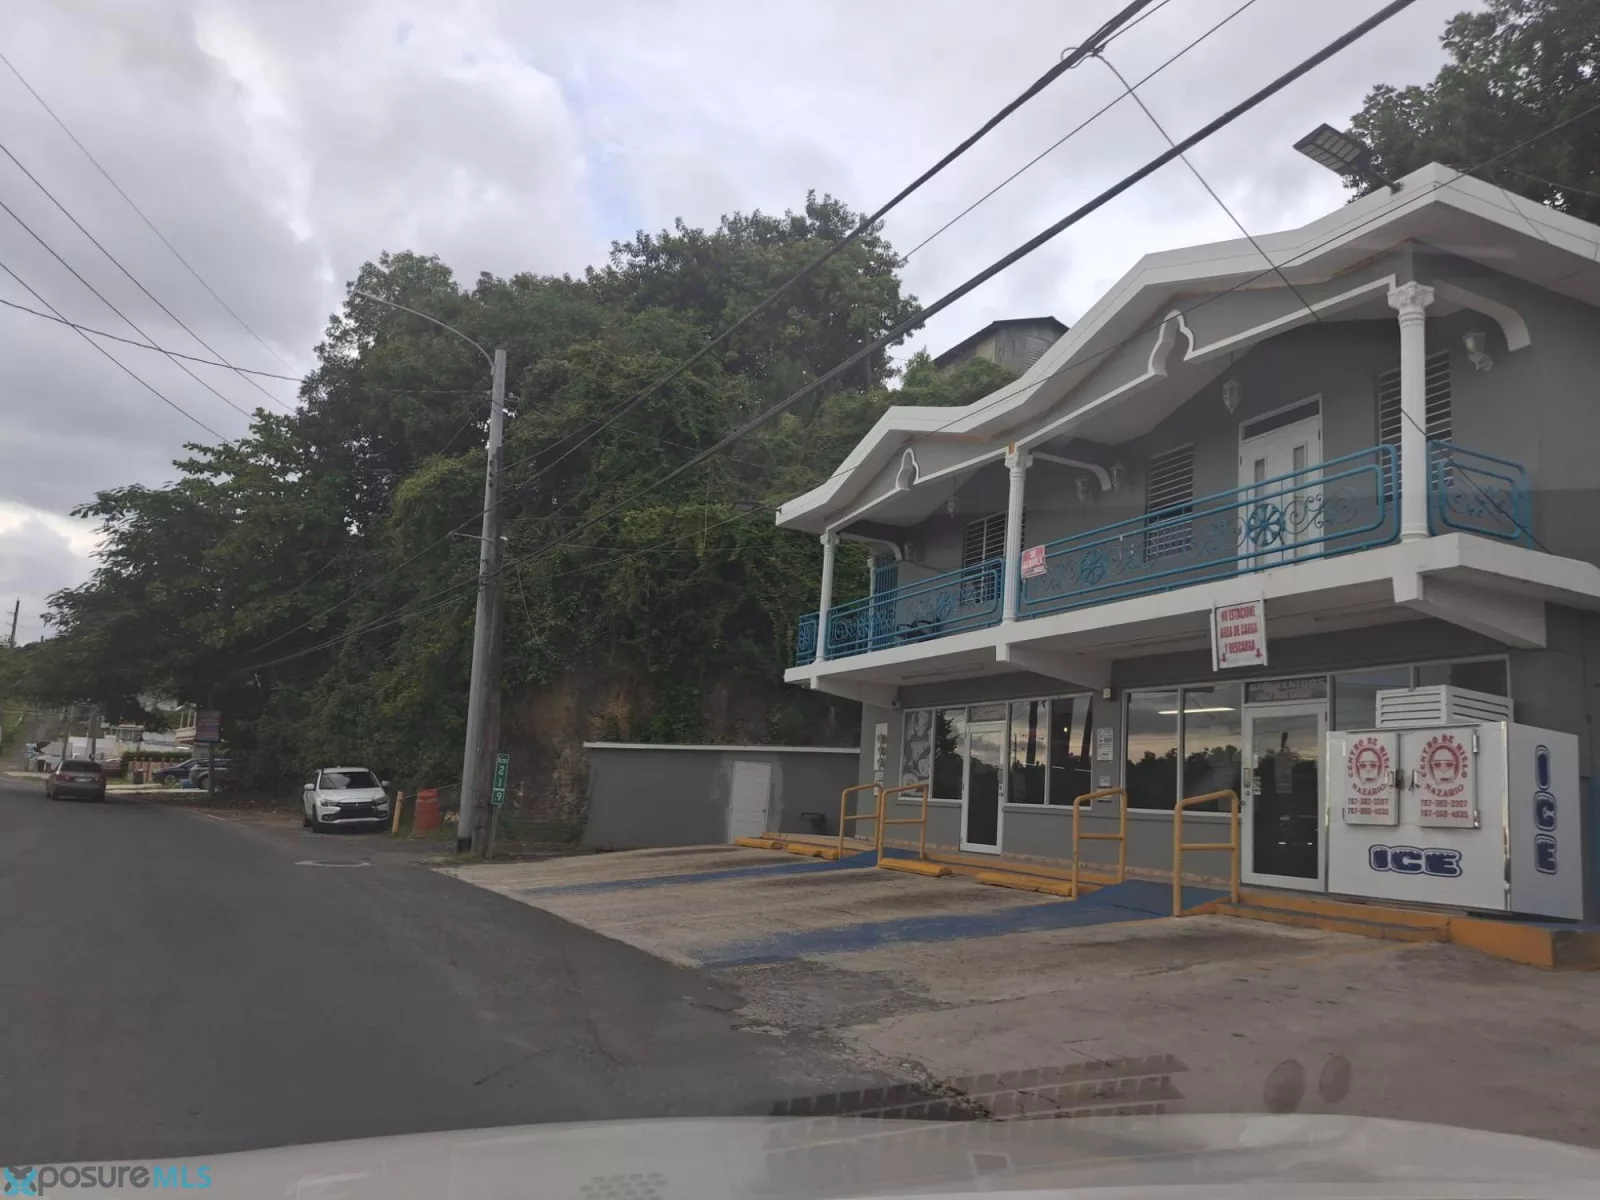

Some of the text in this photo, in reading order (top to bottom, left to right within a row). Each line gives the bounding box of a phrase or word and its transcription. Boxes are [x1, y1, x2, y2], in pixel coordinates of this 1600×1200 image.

[1233, 625, 1240, 636] DE
[1348, 739, 1364, 778] CENTRO
[1367, 737, 1378, 746] DE
[1420, 736, 1438, 778] CENTRO
[1442, 734, 1455, 744] DE
[1351, 783, 1386, 796] NAZARIO
[1424, 783, 1465, 797] NAZARIO
[1535, 745, 1557, 875] ICE
[1369, 844, 1463, 877] ICE
